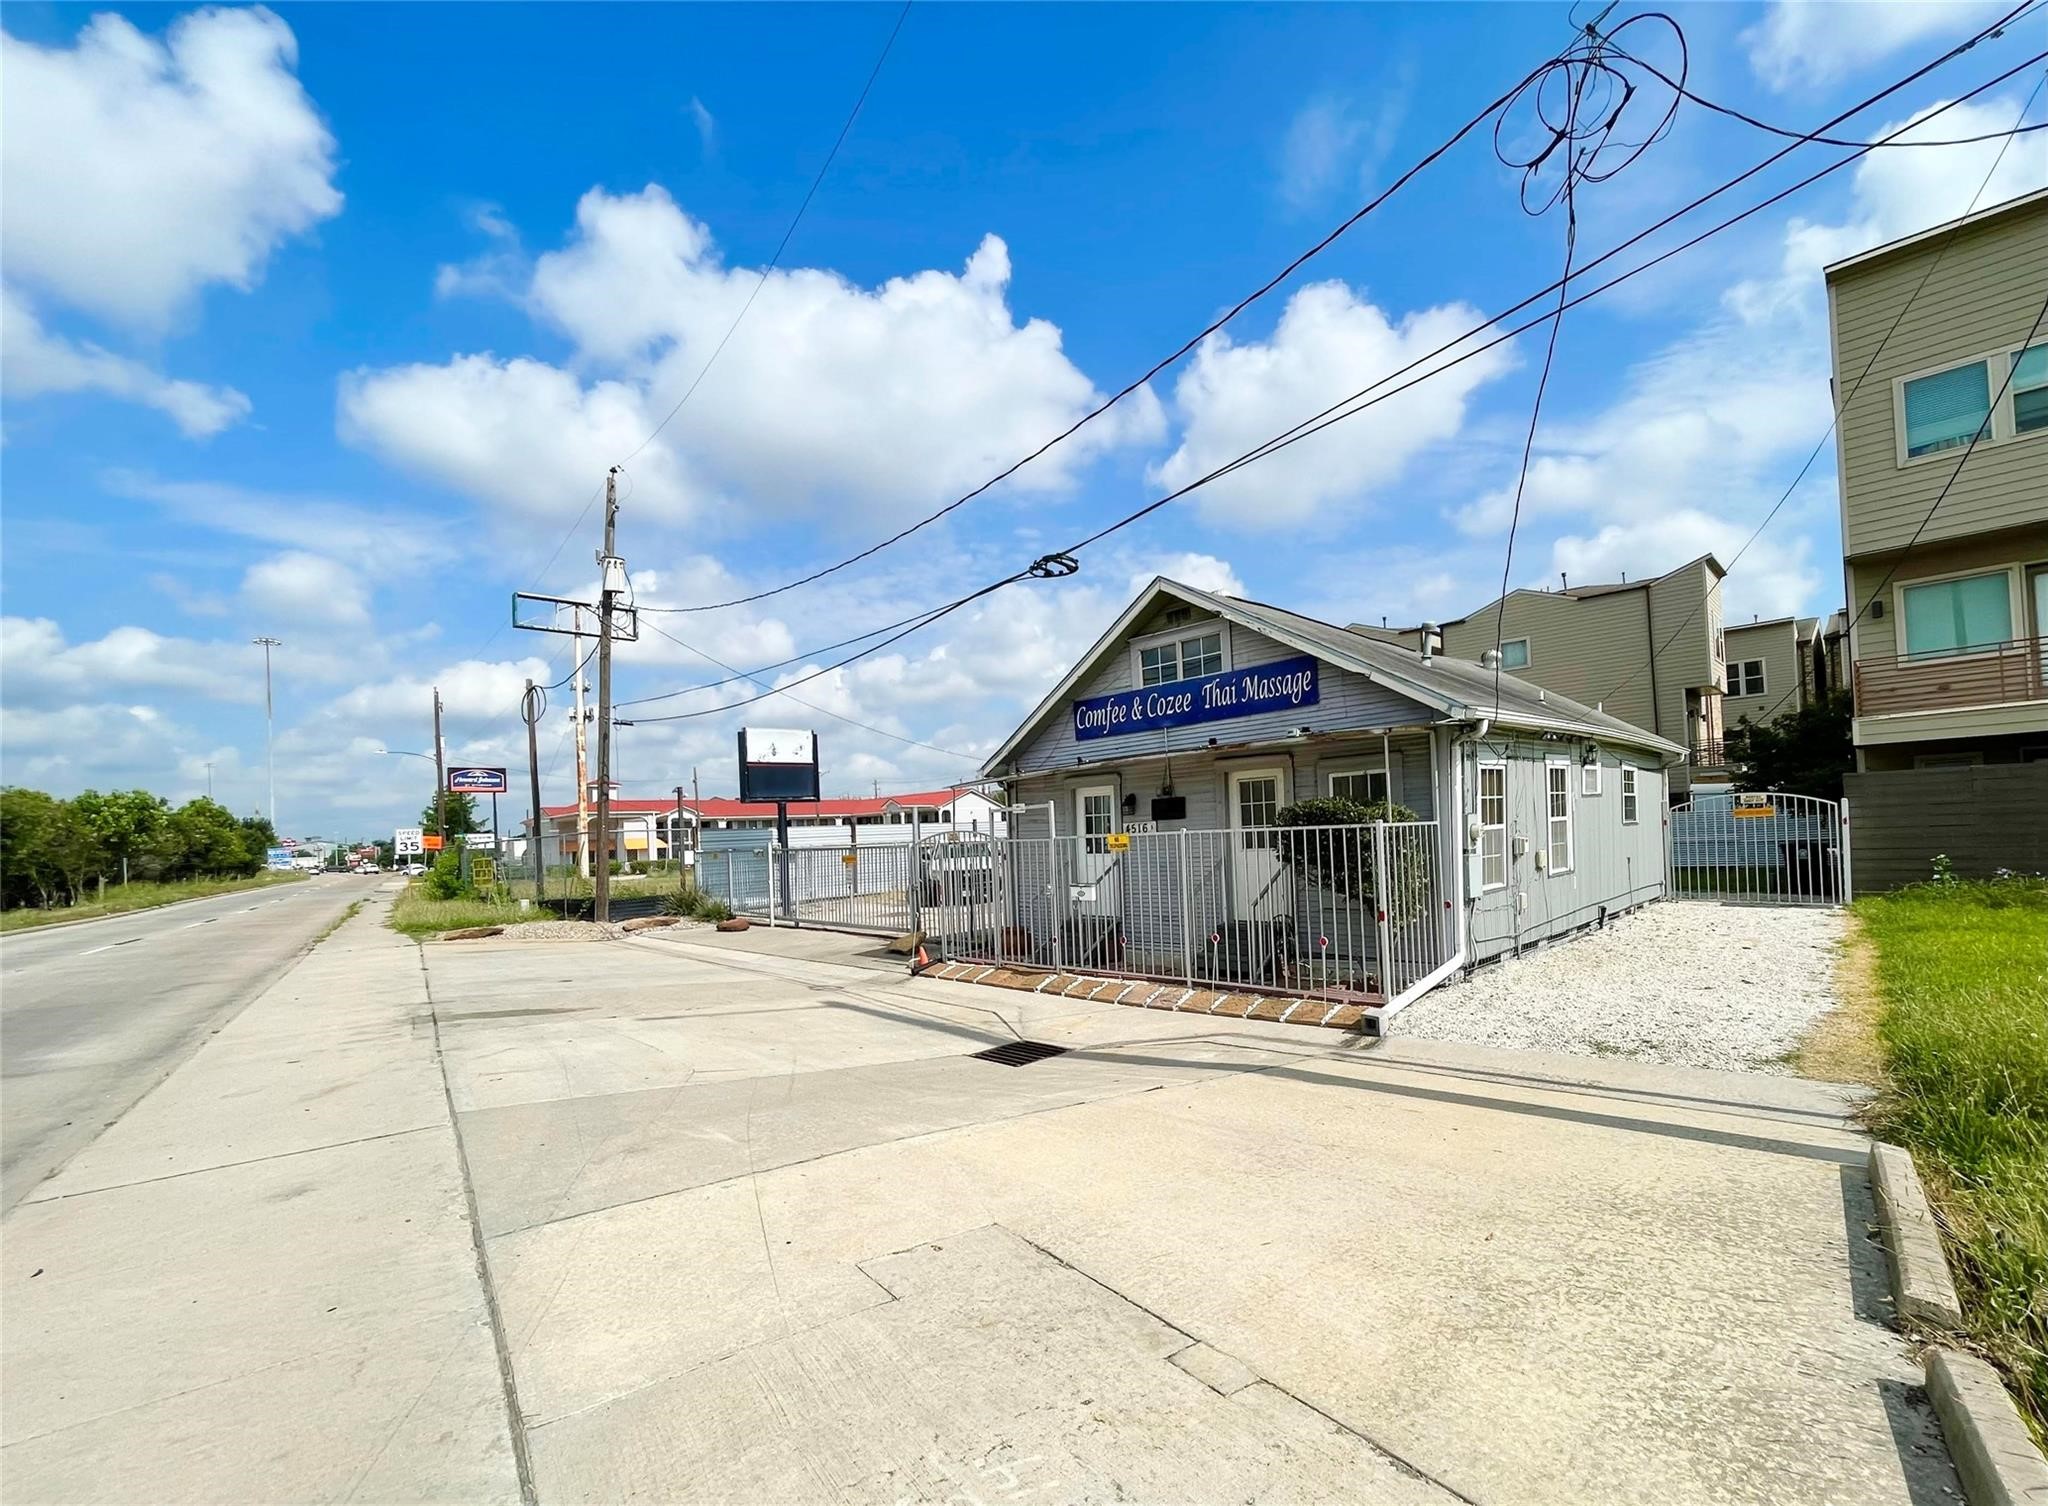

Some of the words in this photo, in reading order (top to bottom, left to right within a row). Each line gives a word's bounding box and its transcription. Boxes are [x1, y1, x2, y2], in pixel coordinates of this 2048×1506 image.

[1076, 698, 1127, 735] Comfee
[1131, 697, 1143, 721] &
[1146, 692, 1192, 718] Cozee
[1201, 678, 1237, 709] Thai
[1241, 670, 1312, 704] Massage
[1126, 823, 1148, 833] 4516
[399, 842, 420, 852] 35
